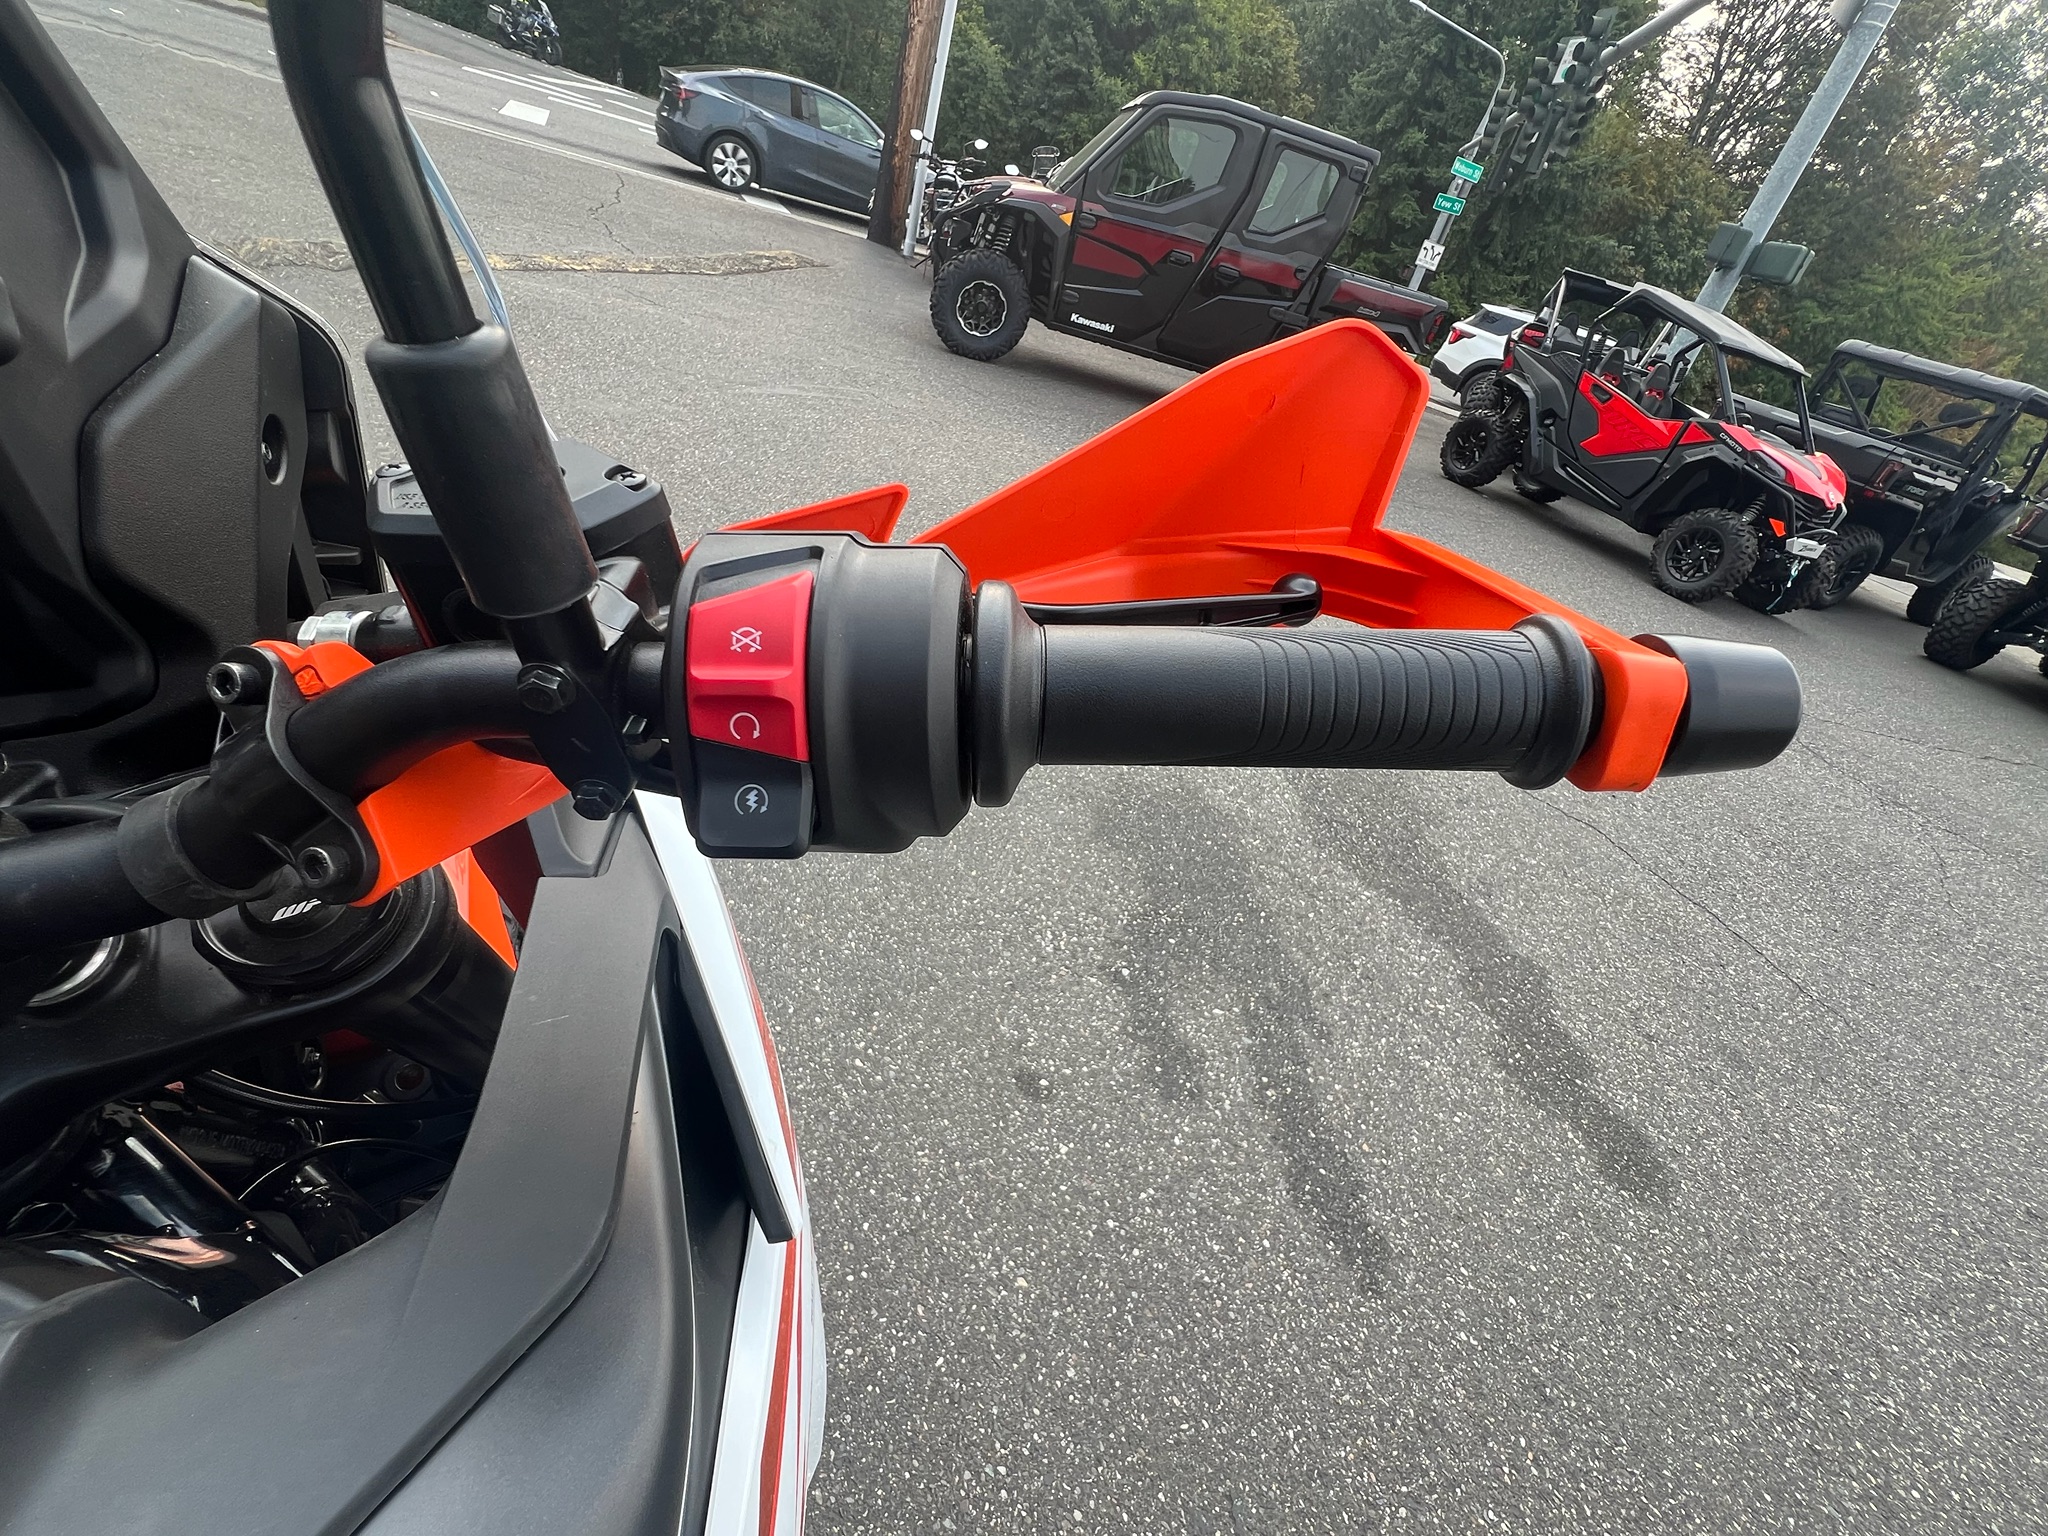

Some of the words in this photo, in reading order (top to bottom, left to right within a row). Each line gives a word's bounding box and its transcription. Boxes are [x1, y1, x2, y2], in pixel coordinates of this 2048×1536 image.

[1437, 198, 1452, 209] Yew
[1453, 202, 1461, 211] St
[1070, 313, 1115, 333] Kawasaki
[1720, 432, 1743, 453] CFMOTO
